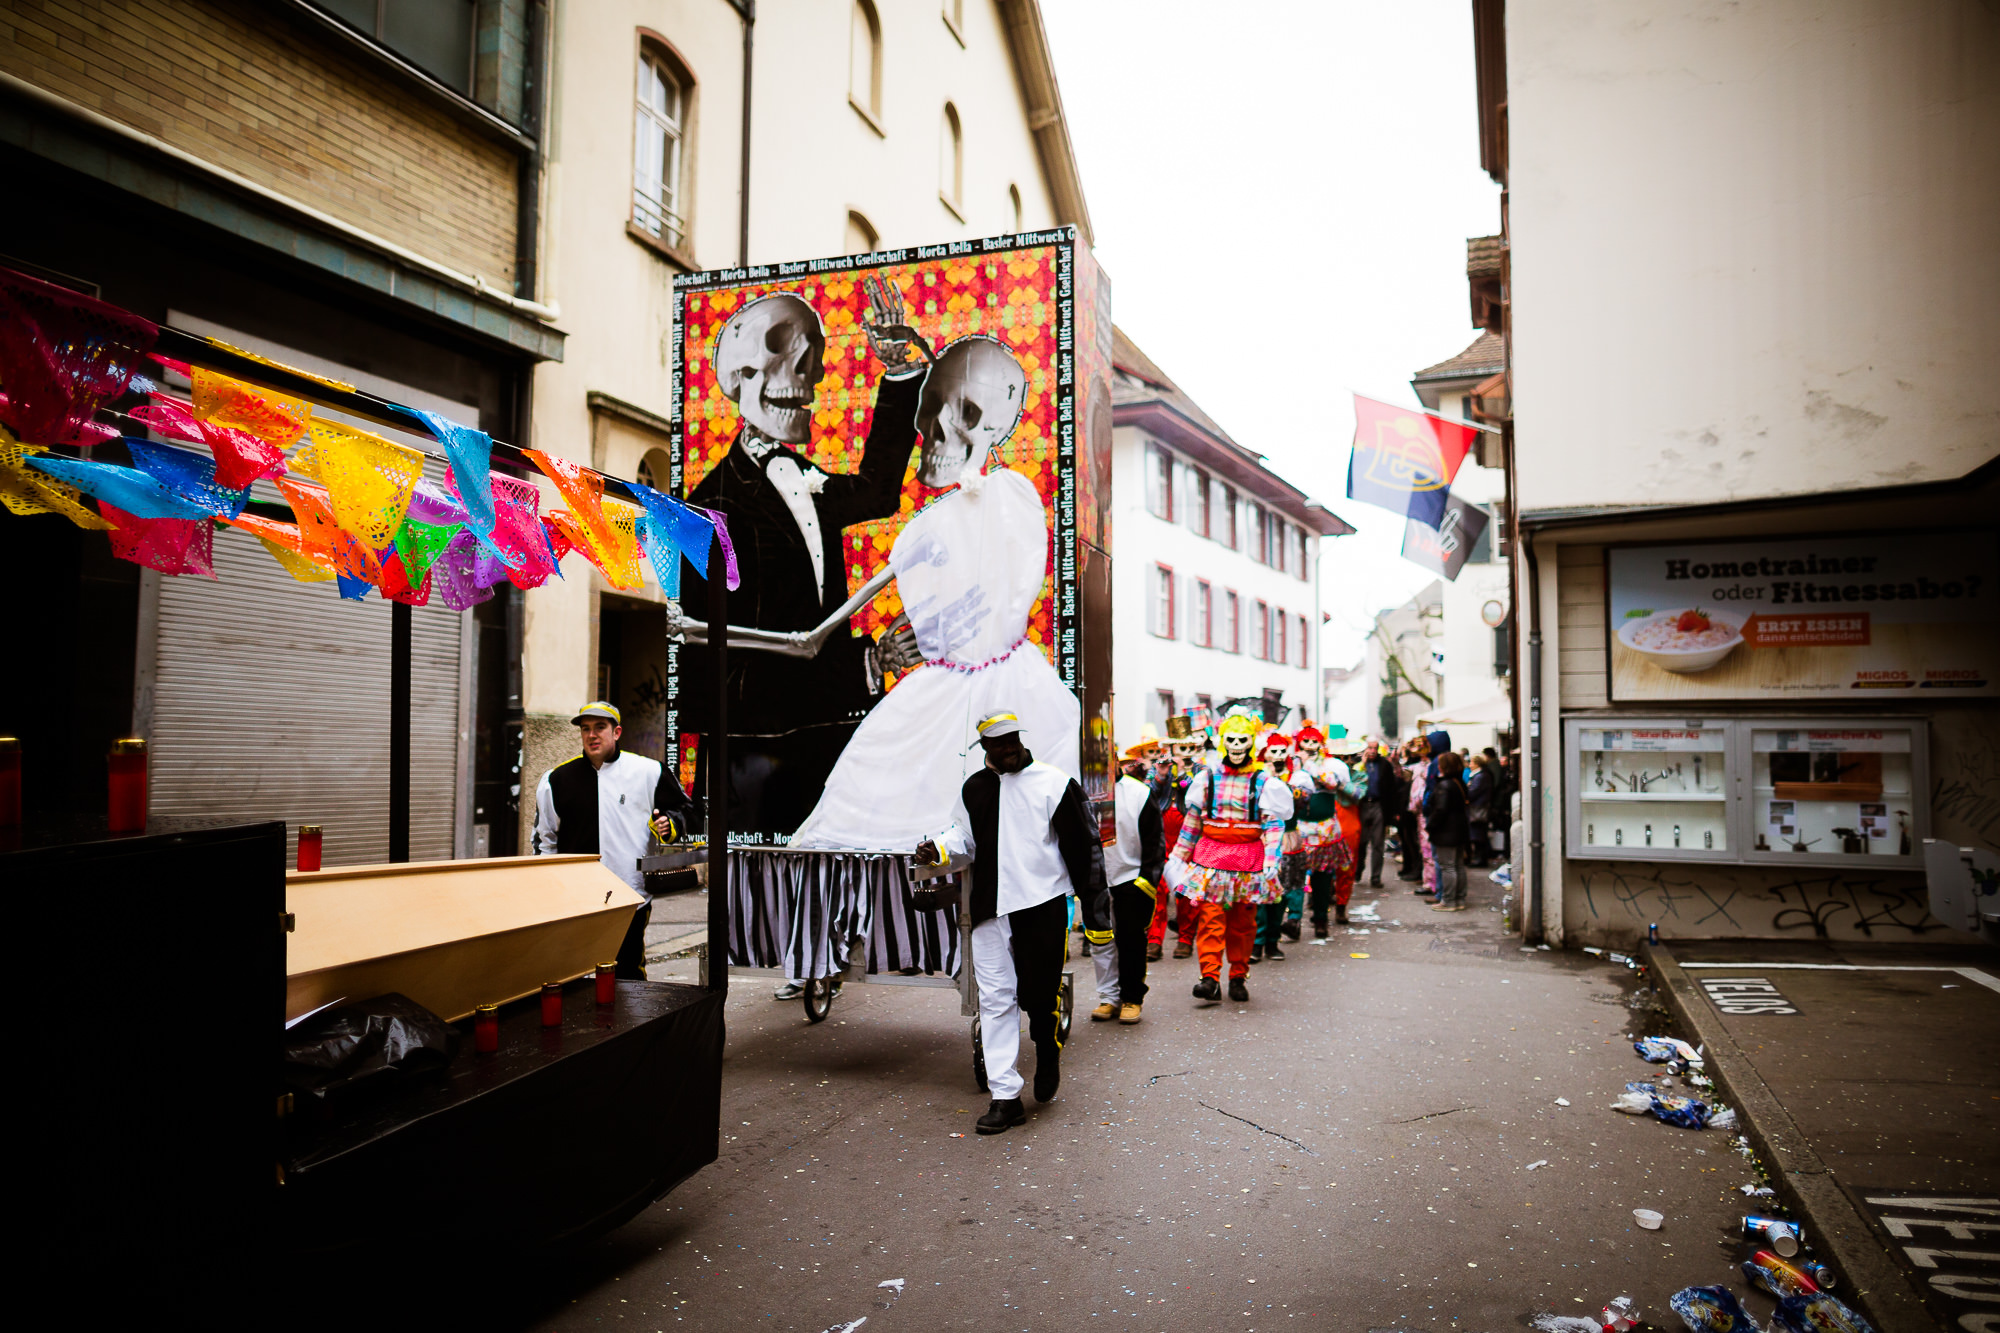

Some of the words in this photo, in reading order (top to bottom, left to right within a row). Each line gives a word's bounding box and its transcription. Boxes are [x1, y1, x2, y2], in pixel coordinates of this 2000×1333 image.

[720, 267, 746, 281] Morta
[748, 265, 770, 278] Bella
[779, 262, 807, 275] Basler
[809, 256, 853, 272] Mittwuch
[855, 249, 907, 266] Gsellschaft
[918, 245, 946, 259] Morta
[949, 241, 972, 255] Bella
[982, 236, 1013, 250] Basler
[1016, 229, 1065, 247] Mittwuch
[1059, 299, 1072, 350] Mittwuch
[1060, 353, 1072, 385] Basler
[1060, 396, 1072, 421] Bella
[671, 434, 682, 462] Morta
[1061, 424, 1073, 455] Morta
[671, 465, 682, 488] Bella
[1061, 468, 1073, 526] Gsellschaft
[1061, 529, 1074, 580] Mittwuch
[1665, 554, 1877, 581] Hometrainer
[1062, 584, 1075, 616] Basler
[1712, 583, 1765, 602] oder
[1771, 574, 1983, 605] Fitnessabo?
[1756, 633, 1786, 643] dann
[1790, 630, 1864, 643] entscheiden
[1757, 619, 1802, 633] ERST
[1806, 618, 1863, 632] ESSEN
[1062, 629, 1075, 653] Bella
[667, 644, 678, 673] Morta
[667, 676, 678, 699] Bella
[1856, 670, 1909, 680] MIGROS
[1925, 669, 1980, 679] MIGROS
[667, 710, 678, 740] Basler
[1700, 978, 1797, 1015] VELOS
